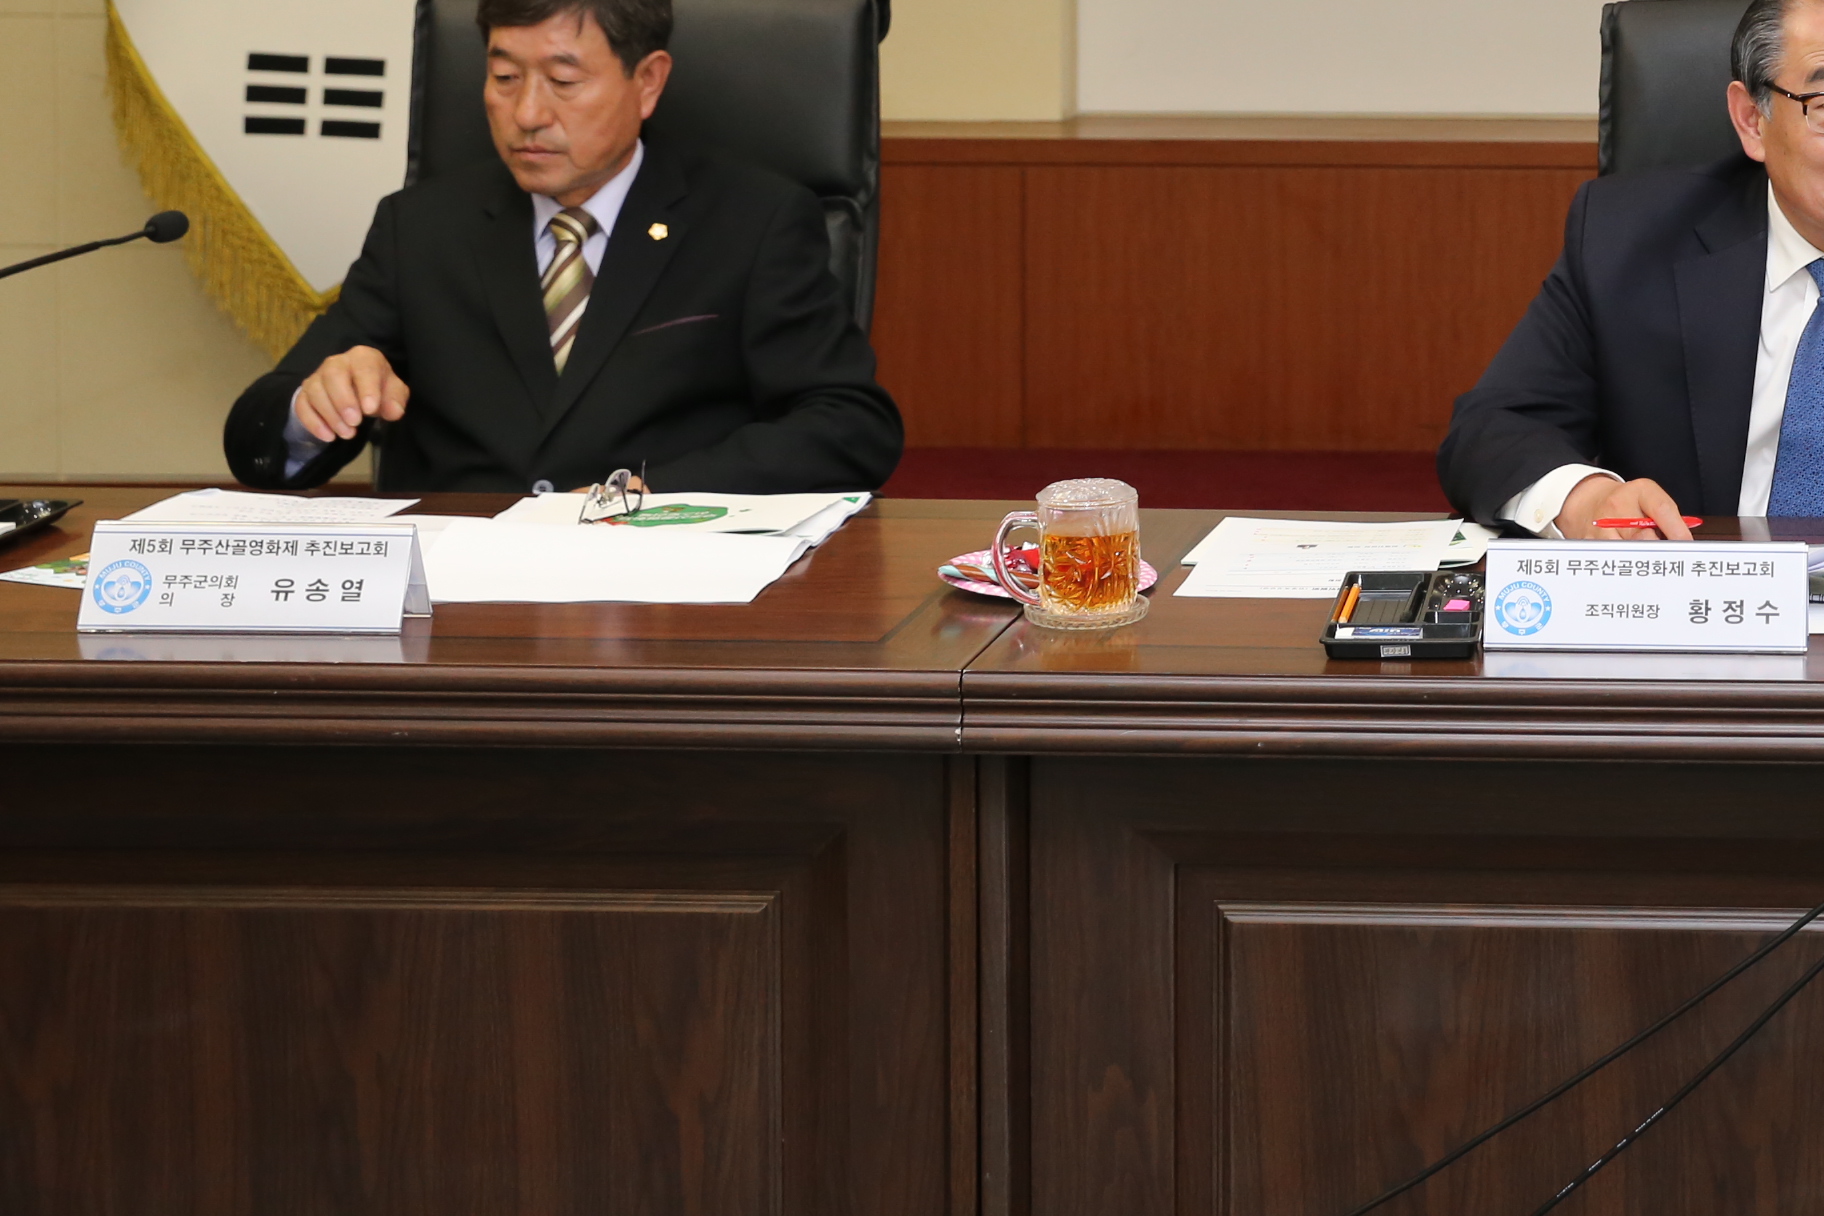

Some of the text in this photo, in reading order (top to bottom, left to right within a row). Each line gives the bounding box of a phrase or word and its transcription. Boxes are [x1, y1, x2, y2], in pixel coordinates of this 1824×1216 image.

[129, 538, 389, 558] 제5회 무주산골영화제 추진보고회
[1516, 558, 1775, 579] 제5회 무주산골영화제 추진보고회
[162, 574, 239, 591] 무주군의회
[1498, 581, 1550, 602] MUJU COUNTY
[1585, 602, 1661, 620] 조직위원장
